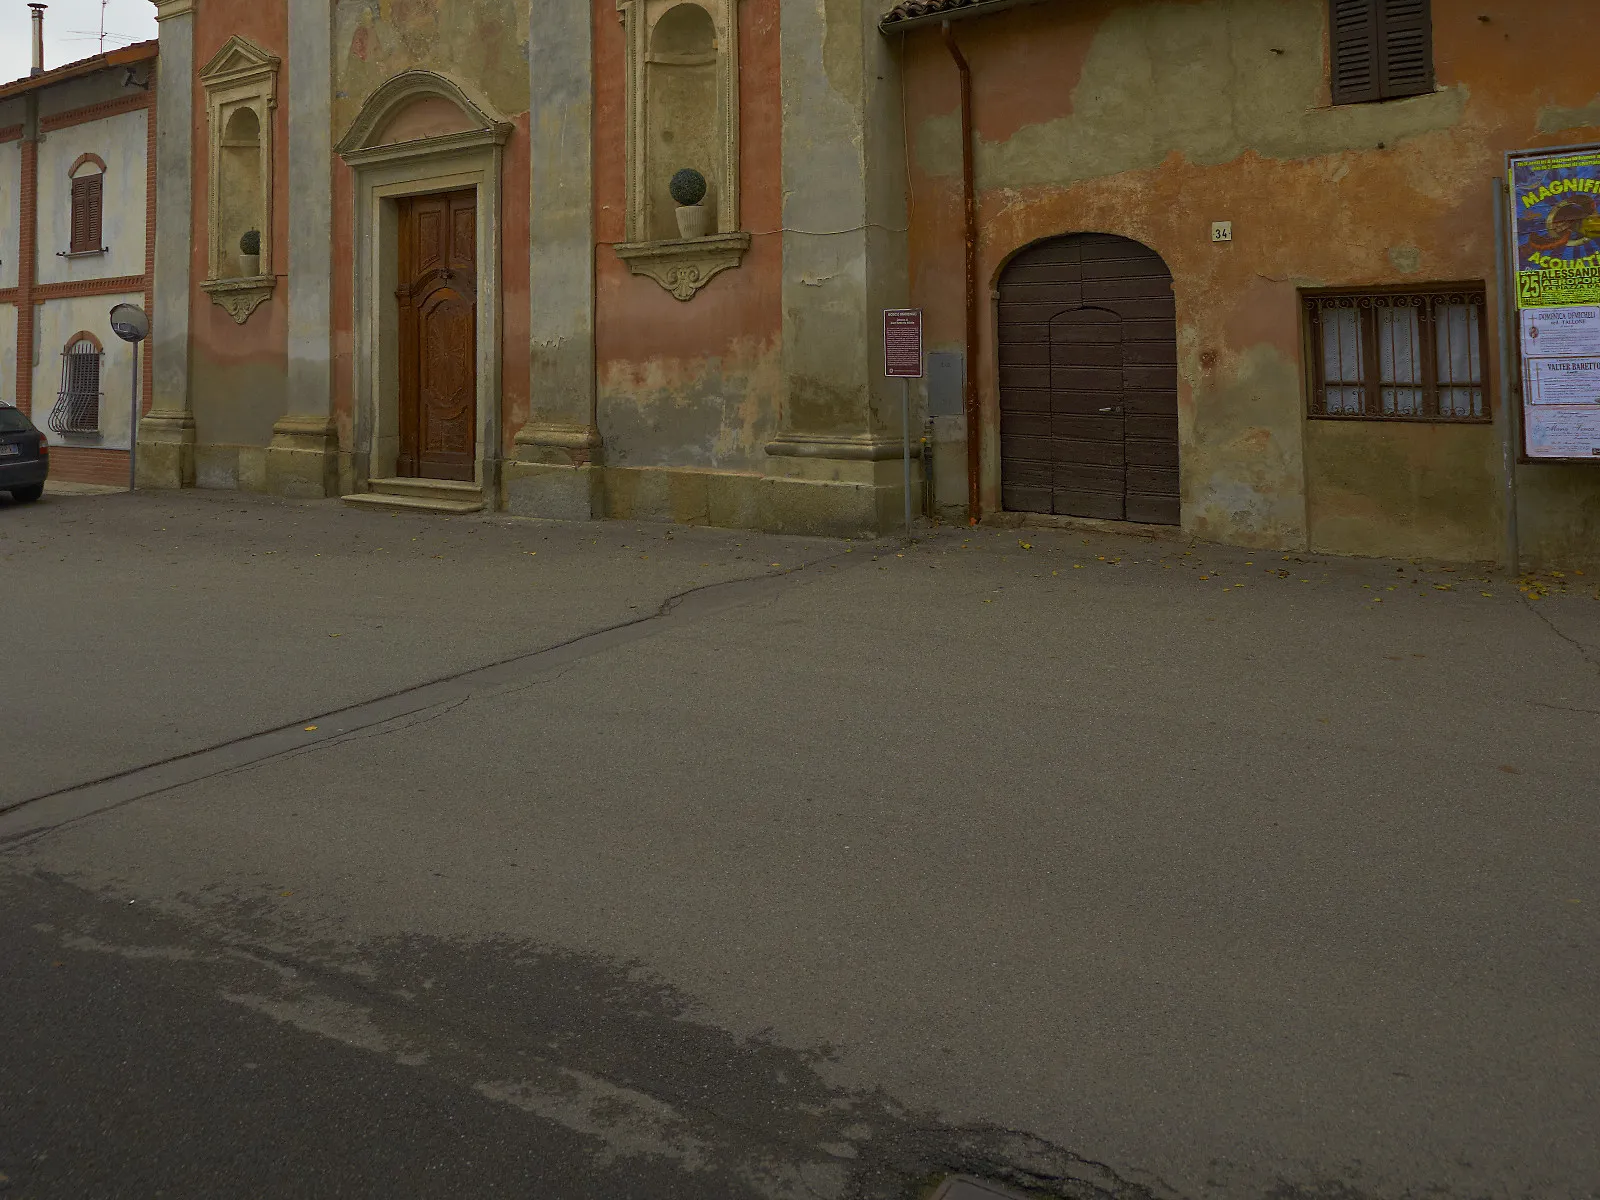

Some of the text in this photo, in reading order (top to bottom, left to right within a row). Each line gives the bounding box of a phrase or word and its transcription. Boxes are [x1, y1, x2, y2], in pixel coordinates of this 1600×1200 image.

[1521, 178, 1600, 208] MAGNIFI
[1215, 228, 1228, 239] 34
[1520, 275, 1540, 298] 25
